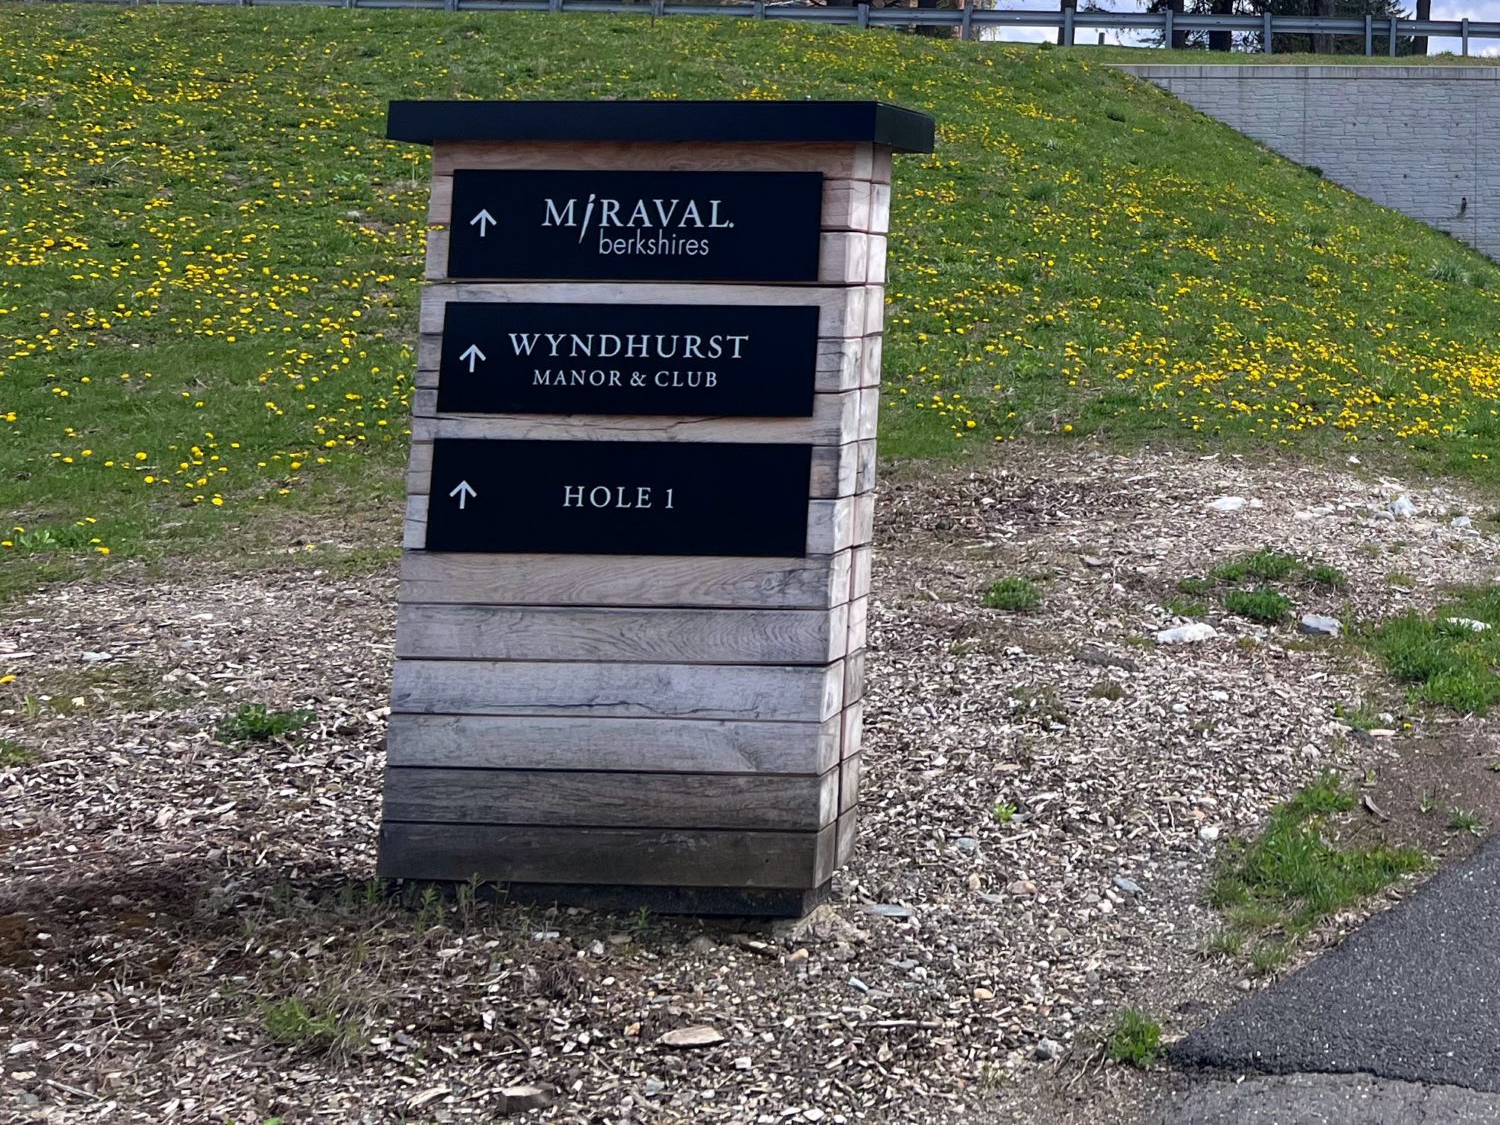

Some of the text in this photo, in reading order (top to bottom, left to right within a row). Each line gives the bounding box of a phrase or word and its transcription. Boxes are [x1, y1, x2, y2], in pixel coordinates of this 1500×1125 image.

[599, 228, 709, 255] berkshires
[508, 332, 749, 359] WYNDHURST
[532, 369, 718, 388] MANOR & CLUB
[562, 485, 675, 509] HOLE 1
